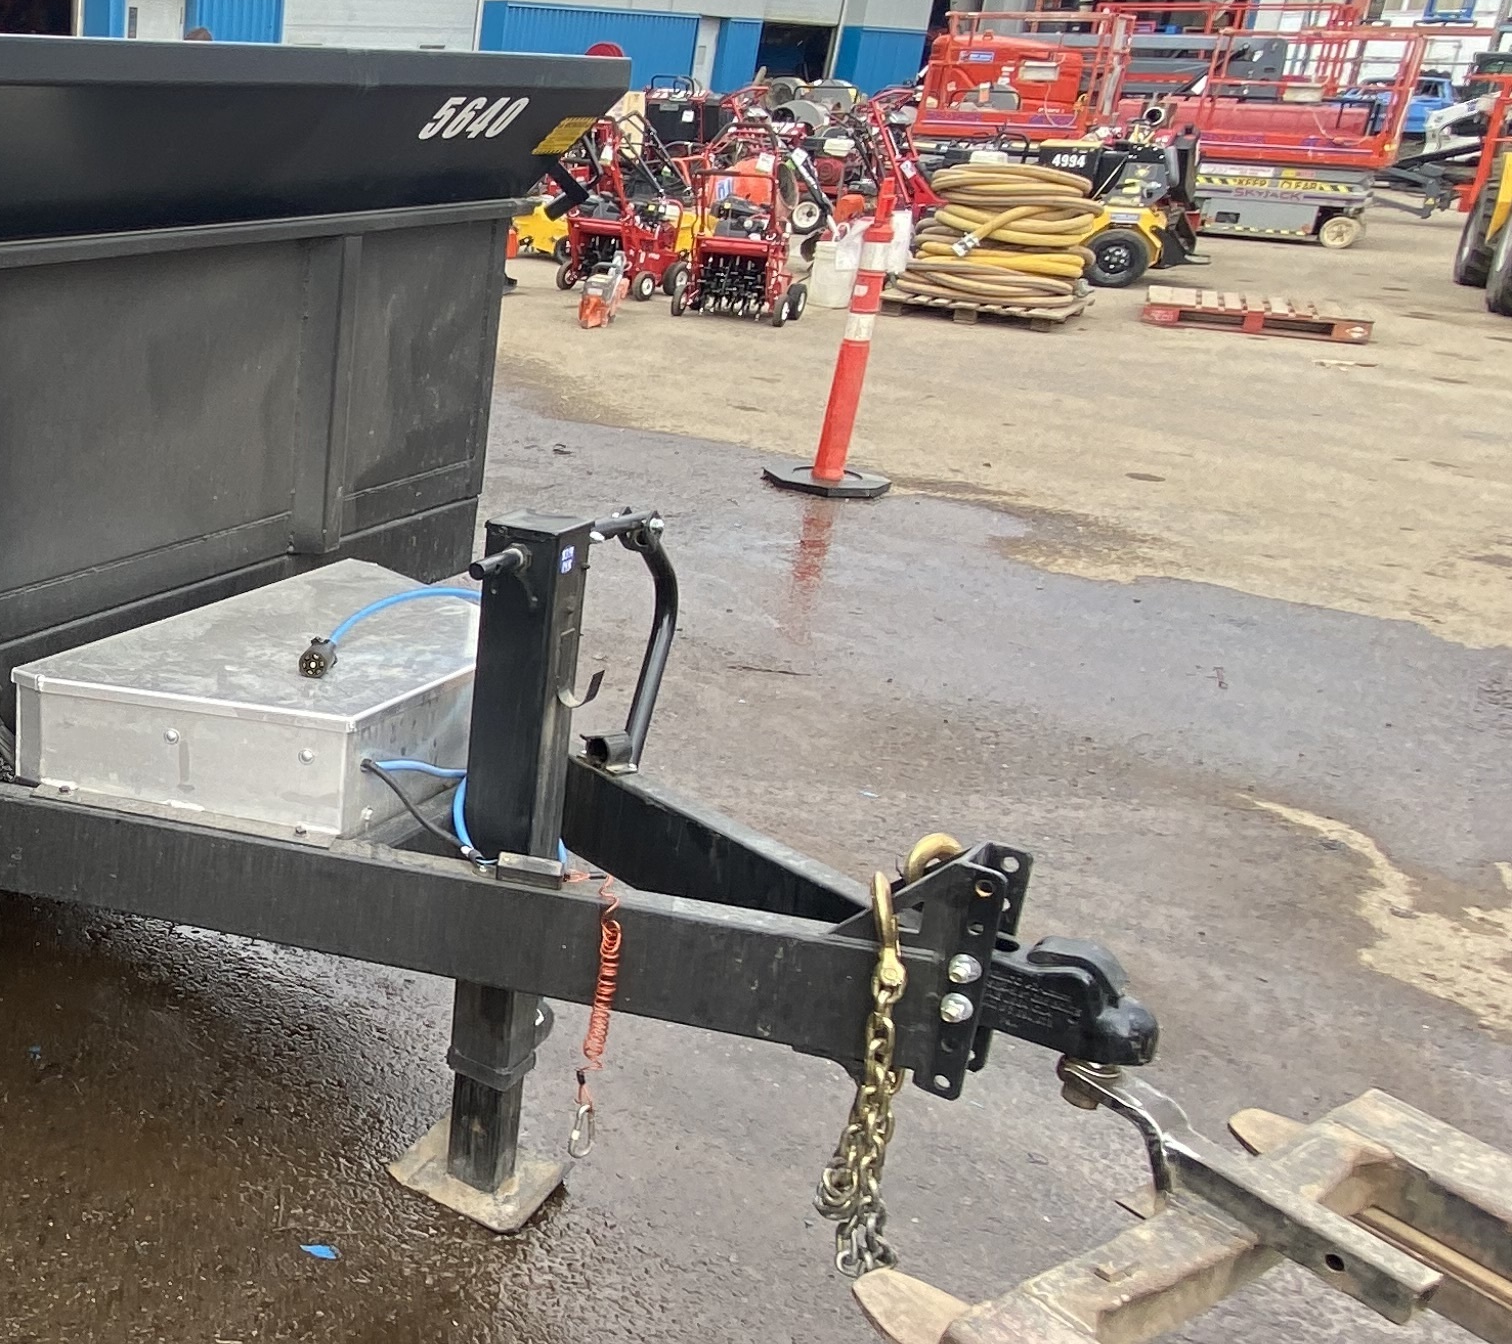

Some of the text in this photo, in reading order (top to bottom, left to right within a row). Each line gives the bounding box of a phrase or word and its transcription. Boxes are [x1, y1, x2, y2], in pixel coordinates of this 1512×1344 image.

[417, 96, 530, 141] 5640
[1051, 153, 1086, 169] 4994
[1232, 187, 1302, 201] SKYJACK
